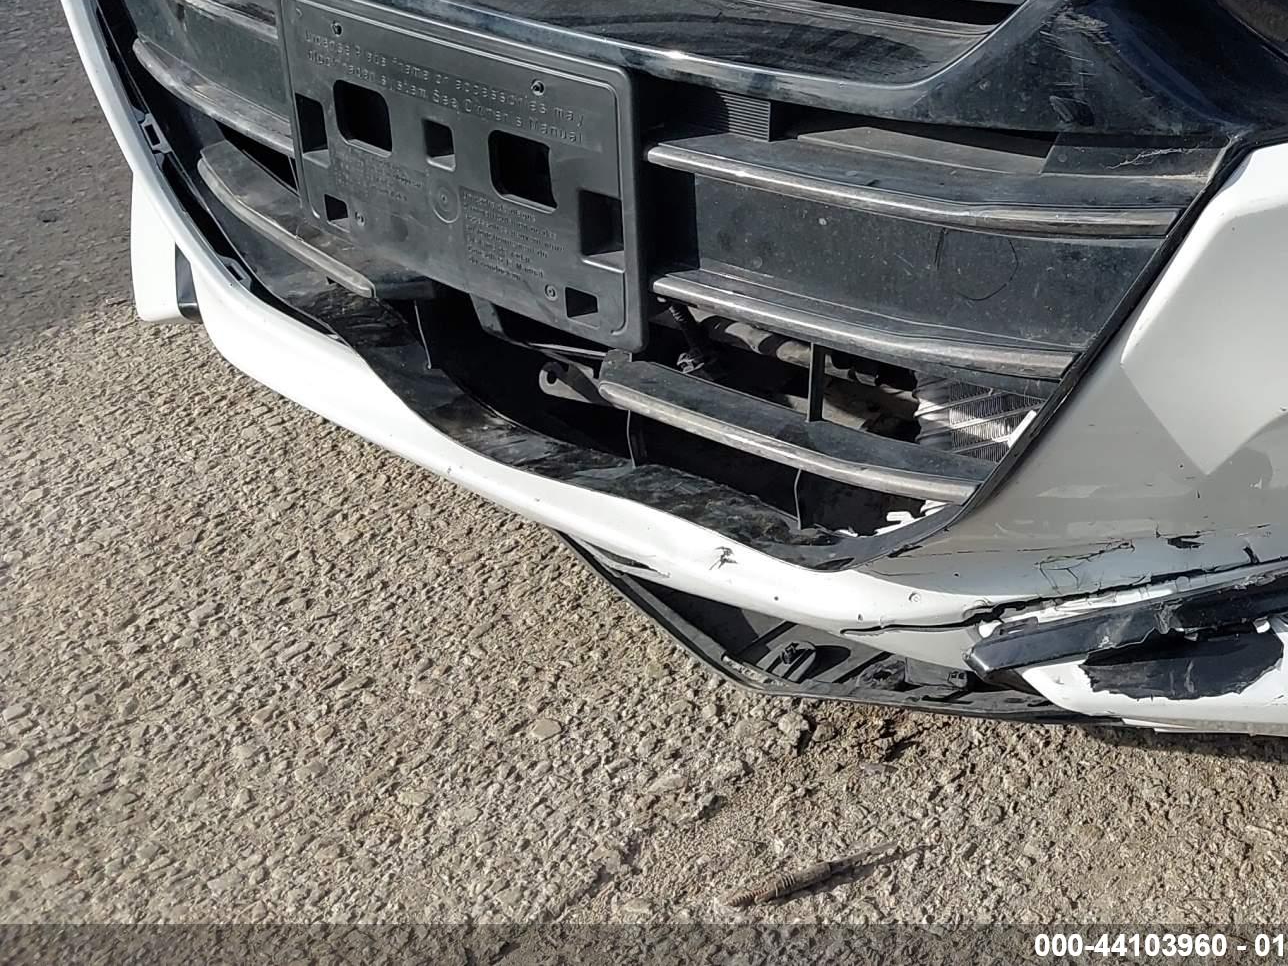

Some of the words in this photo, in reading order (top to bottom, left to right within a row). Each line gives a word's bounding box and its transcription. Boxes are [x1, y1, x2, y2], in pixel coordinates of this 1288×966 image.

[355, 44, 386, 68] Pate
[455, 78, 547, 114] accessories
[554, 105, 584, 128] may
[381, 74, 427, 98] sstem
[464, 98, 523, 127] Owners
[528, 116, 583, 143] Manual
